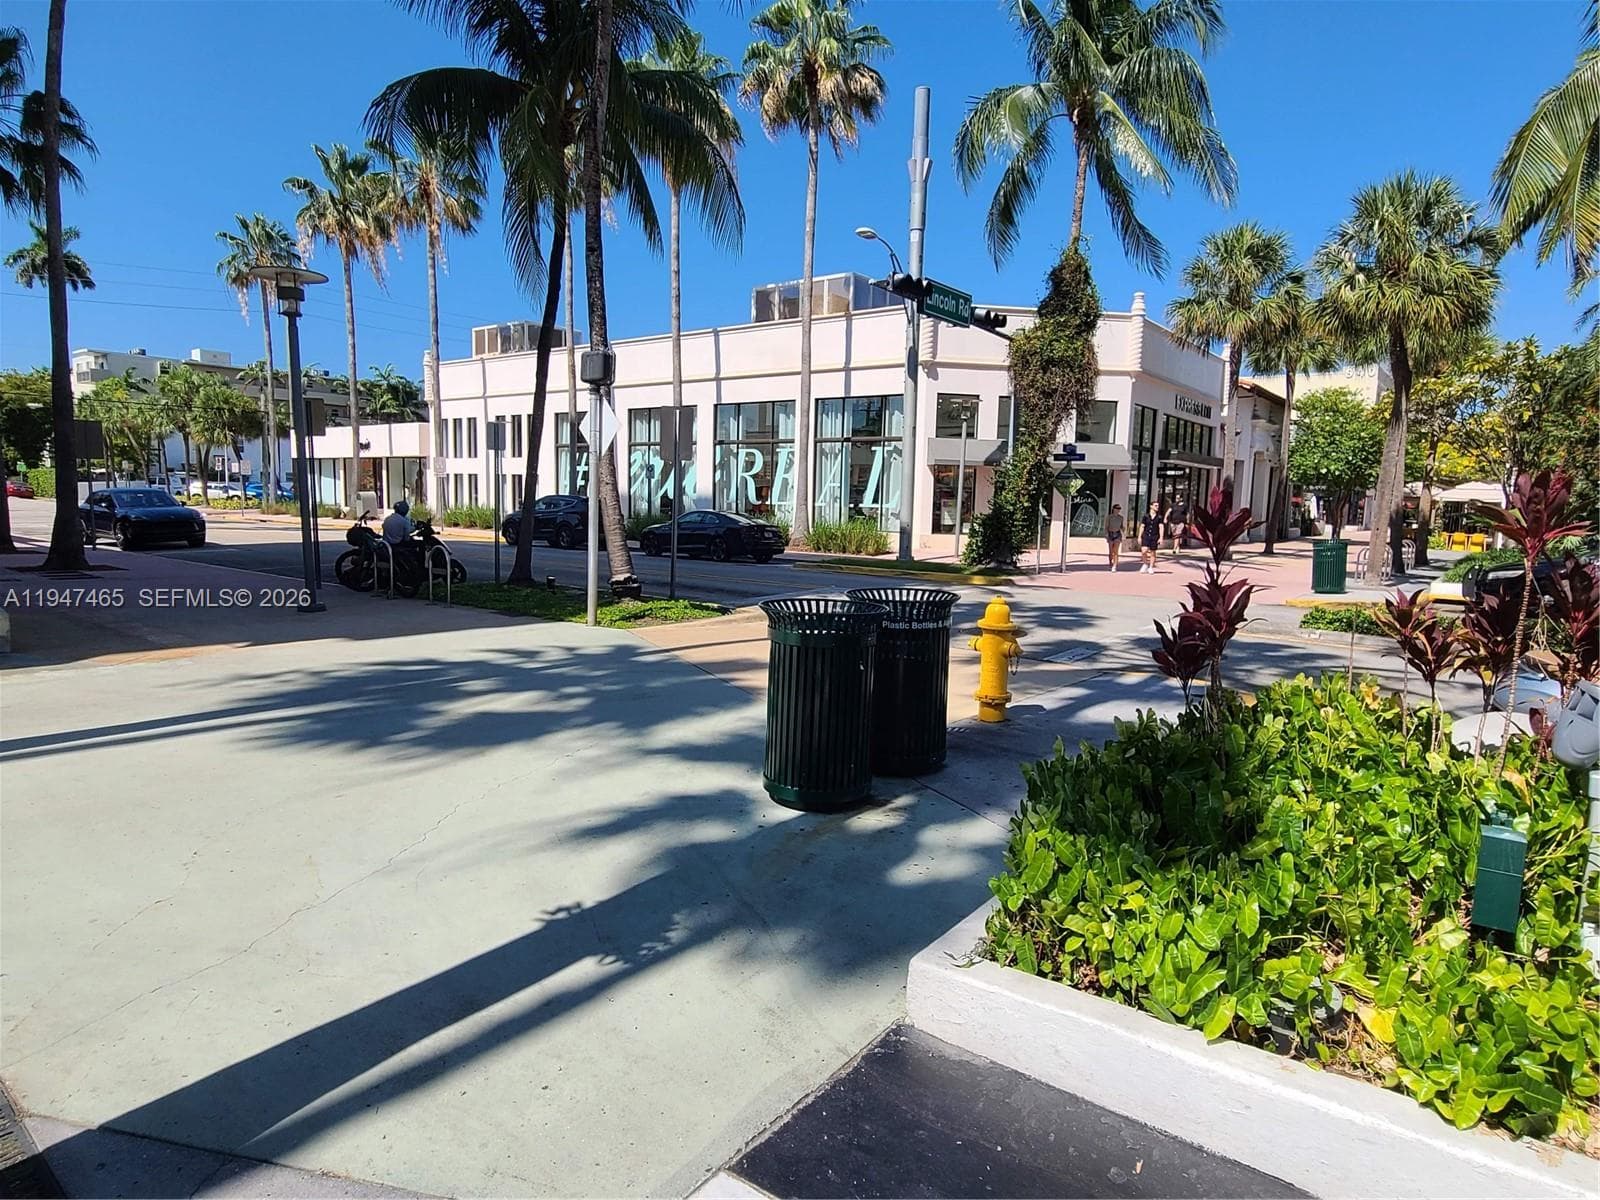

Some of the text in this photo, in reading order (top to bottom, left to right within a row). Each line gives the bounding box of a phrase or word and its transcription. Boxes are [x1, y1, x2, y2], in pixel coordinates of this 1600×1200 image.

[926, 288, 970, 318] Lincoln Rd
[882, 620, 910, 630] Plastic
[911, 621, 937, 630] Bottles
